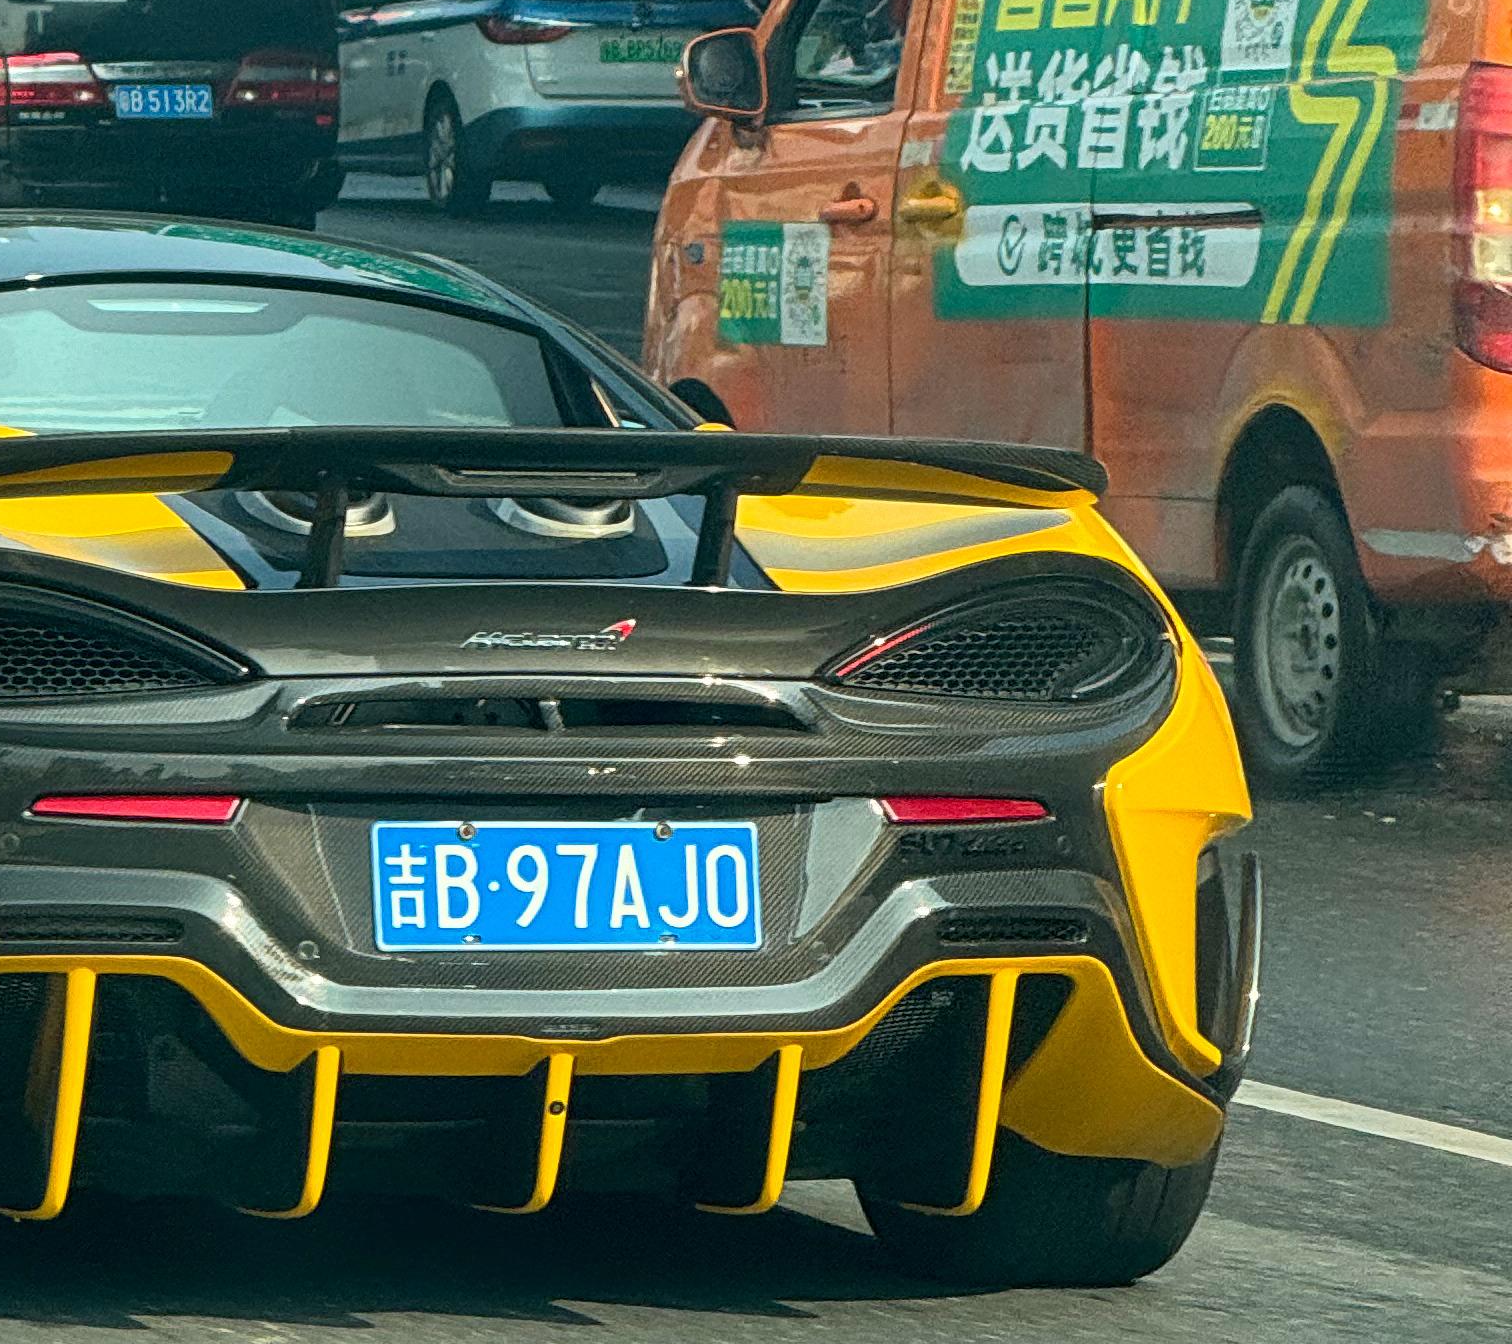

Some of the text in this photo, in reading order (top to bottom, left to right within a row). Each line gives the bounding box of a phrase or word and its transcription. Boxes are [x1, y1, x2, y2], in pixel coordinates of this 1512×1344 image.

[961, 43, 1209, 173] 送货省钱
[385, 843, 750, 930] 吉B·97AJ0
